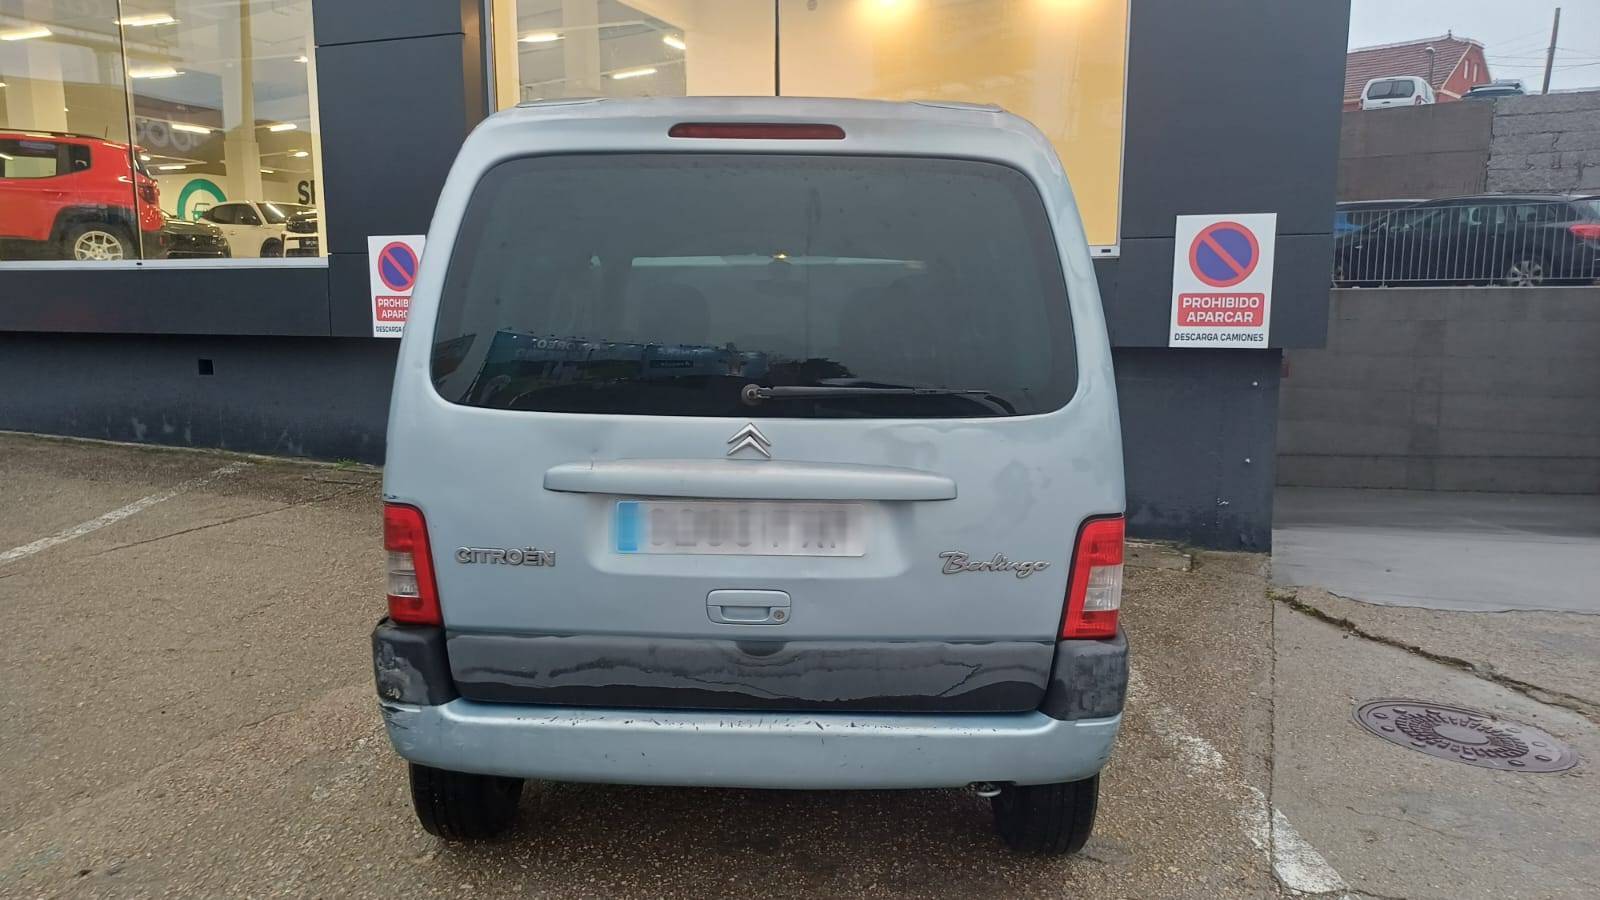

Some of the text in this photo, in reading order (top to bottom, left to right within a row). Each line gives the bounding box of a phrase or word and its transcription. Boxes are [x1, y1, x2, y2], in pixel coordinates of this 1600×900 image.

[378, 298, 409, 308] PROHIB
[1182, 297, 1259, 309] PROHIBIDO
[1186, 311, 1254, 323] APARCAR
[1174, 333, 1264, 342] DESCARGA CAMIONES
[455, 546, 556, 567] CITROËN
[939, 550, 1051, 579] Berlingo
